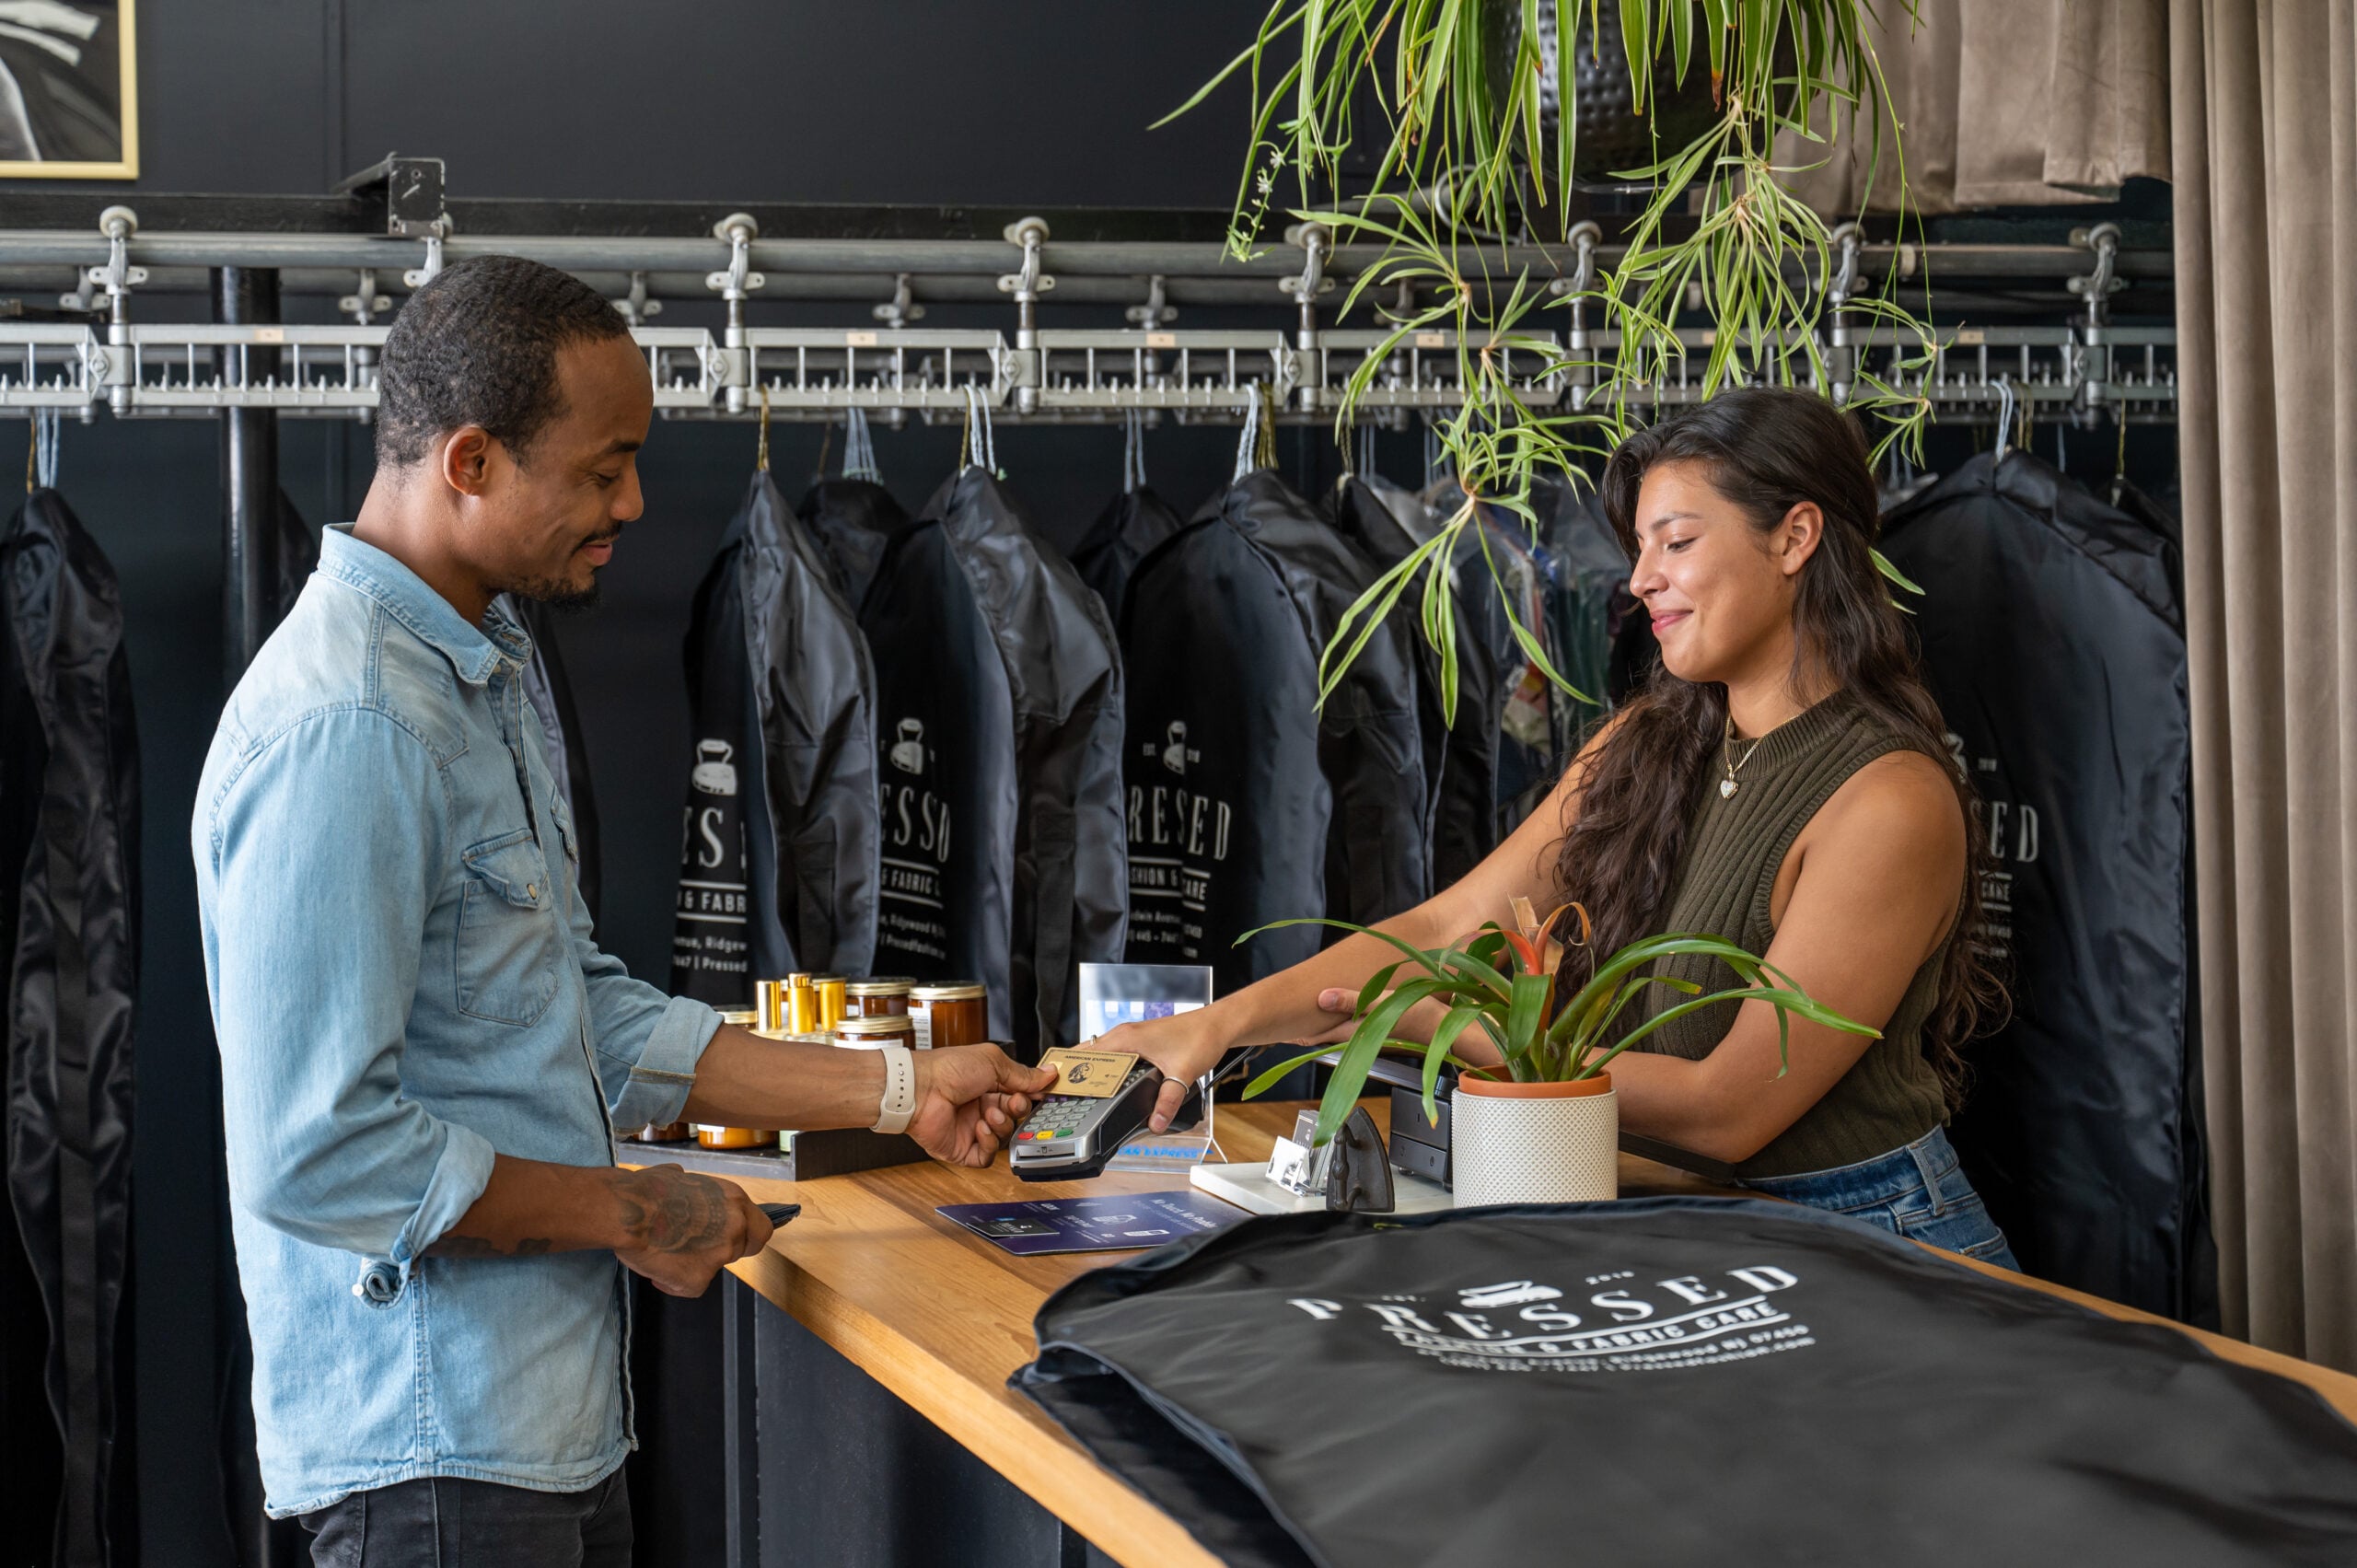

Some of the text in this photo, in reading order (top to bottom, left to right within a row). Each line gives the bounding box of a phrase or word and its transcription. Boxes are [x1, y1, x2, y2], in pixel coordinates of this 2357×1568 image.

[1286, 1265, 1799, 1340] PRESSED
[1571, 1324, 1686, 1352] FABRIC
[1694, 1300, 1779, 1330] CARE
